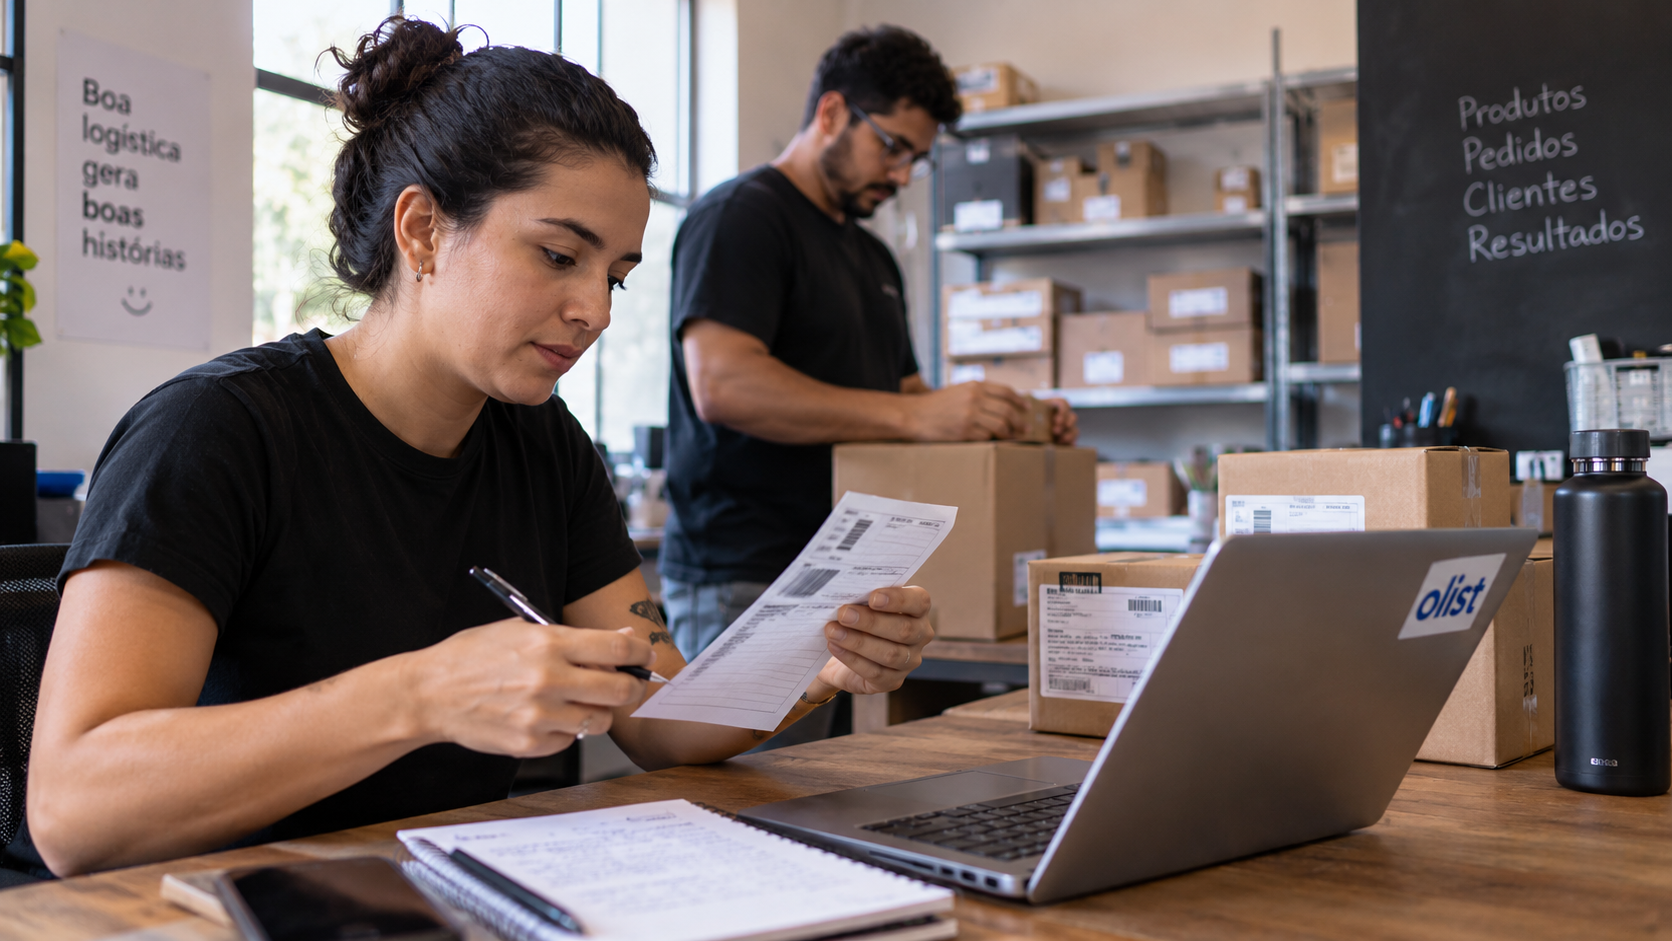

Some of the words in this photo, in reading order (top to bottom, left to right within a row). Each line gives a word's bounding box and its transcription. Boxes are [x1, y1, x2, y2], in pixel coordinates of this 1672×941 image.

[83, 77, 131, 115] Boa
[1458, 82, 1587, 131] Produtos
[83, 112, 182, 162] logística
[1462, 127, 1578, 175] Pedidos
[82, 160, 139, 190] gera
[1463, 170, 1598, 217] Clientes
[83, 190, 144, 229] boas
[83, 227, 187, 271] histórias
[1468, 208, 1645, 263] Resultados
[1416, 574, 1485, 621] olist
